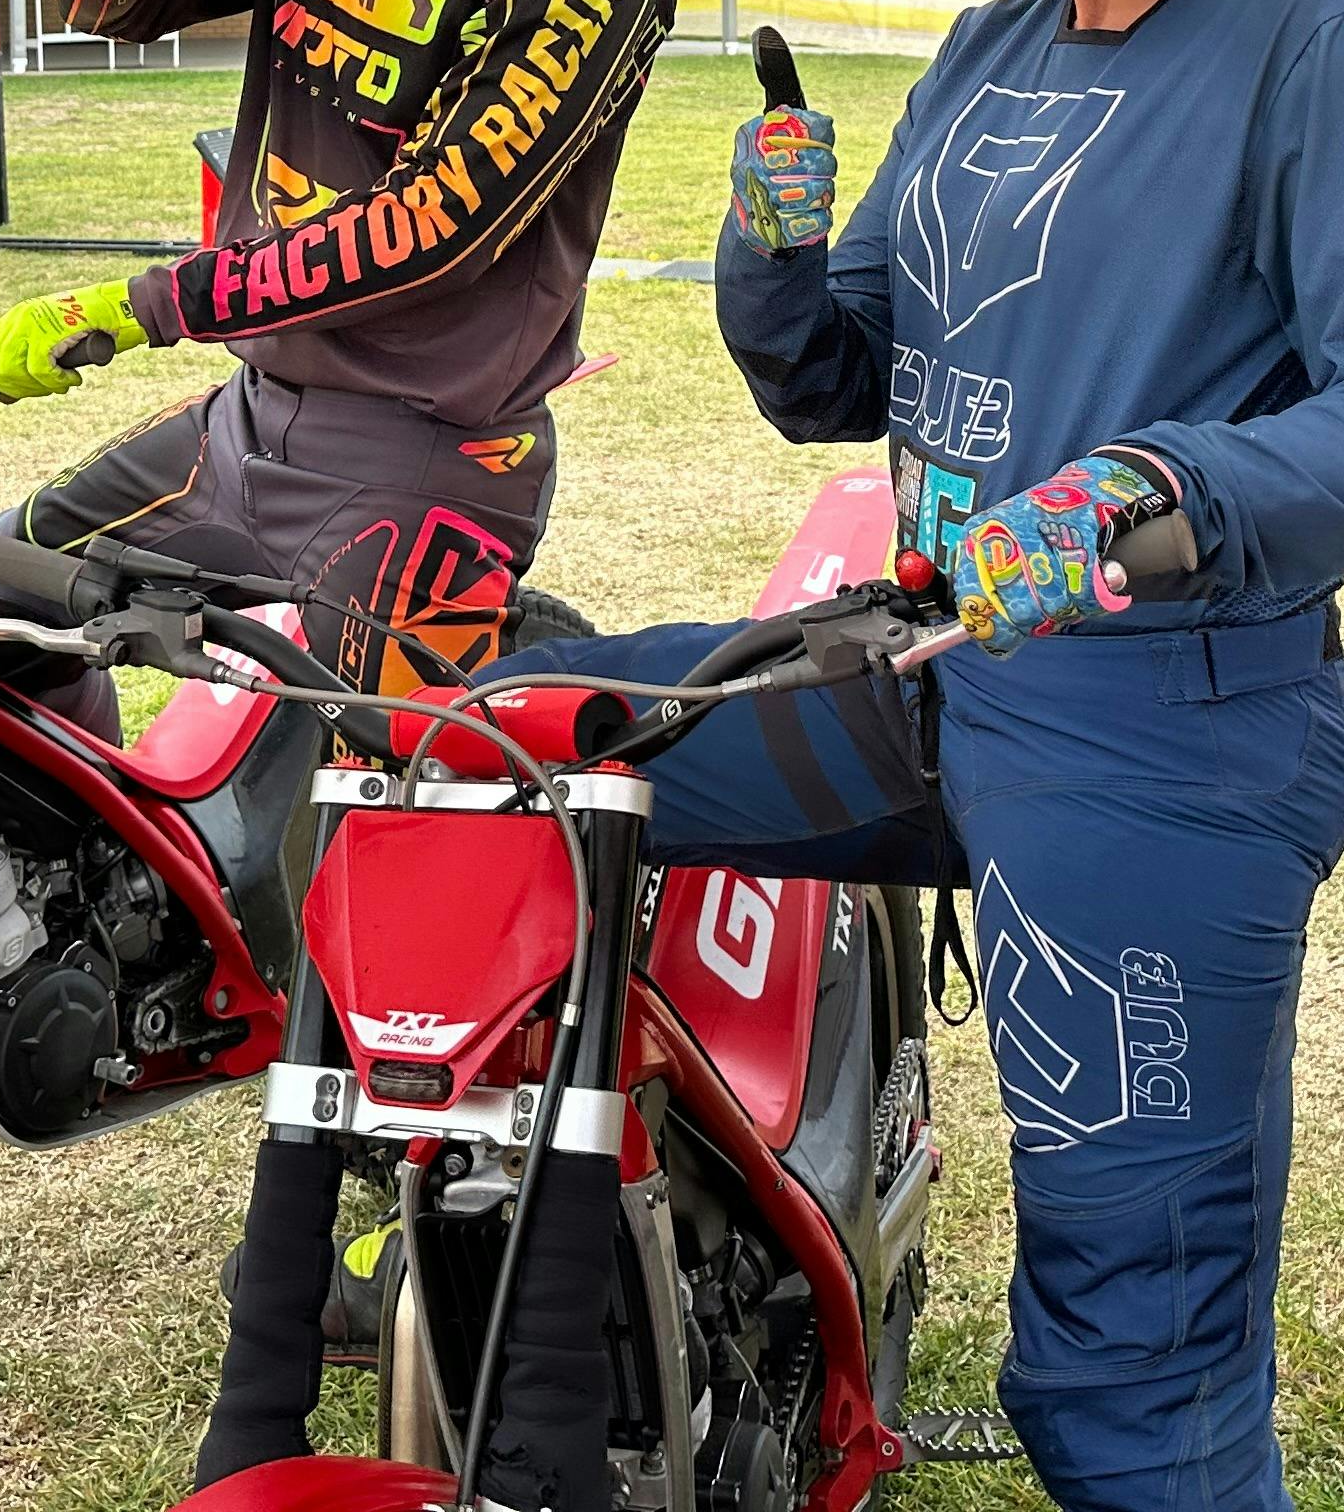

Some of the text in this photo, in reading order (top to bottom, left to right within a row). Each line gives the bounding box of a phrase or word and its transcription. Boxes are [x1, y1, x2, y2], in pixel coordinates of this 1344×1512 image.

[212, 145, 482, 322] FACTORY
[1143, 492, 1166, 510] FIST
[641, 864, 665, 932] TXT
[832, 882, 854, 956] TXT
[377, 1033, 435, 1048] RACING
[385, 1009, 446, 1030] TXT
[1120, 946, 1191, 1120] DUB
